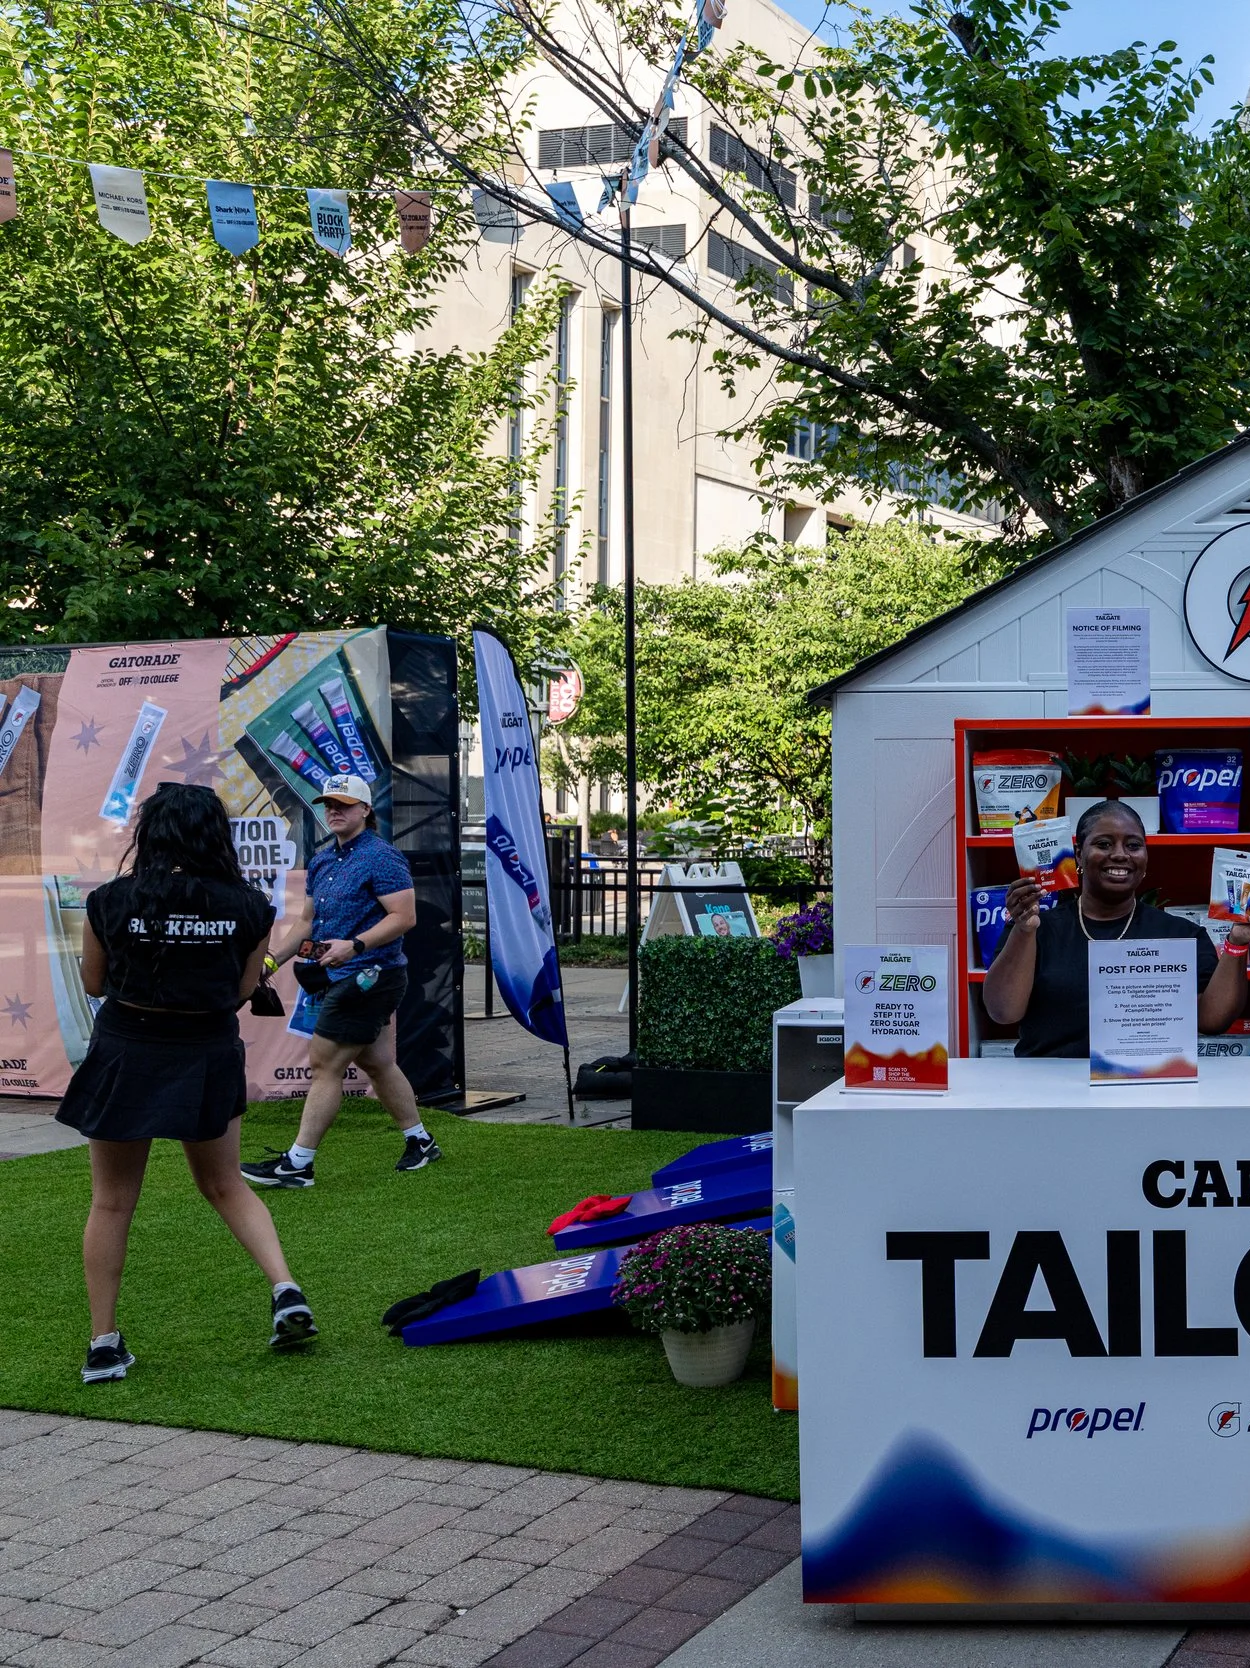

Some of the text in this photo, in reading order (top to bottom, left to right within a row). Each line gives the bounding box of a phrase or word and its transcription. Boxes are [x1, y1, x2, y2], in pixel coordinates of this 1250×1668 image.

[98, 191, 143, 205] MICHAEL KORS
[316, 212, 344, 228] BLOCK
[317, 225, 345, 240] PARTY
[109, 654, 181, 669] GATORADE
[118, 676, 133, 687] OFF
[139, 675, 150, 686] TO
[150, 673, 180, 685] COLLEGE
[124, 736, 147, 779] ZERO
[337, 722, 378, 783] propel
[997, 774, 1048, 790] ZERO
[1158, 765, 1243, 795] propel
[1028, 839, 1059, 851] TAILGATE
[182, 920, 237, 936] PARTY
[879, 955, 912, 963] TAILGATE
[1098, 964, 1188, 974] POST FOR PERKS
[878, 974, 937, 992] ZERO
[875, 1003, 914, 1011] READY TO
[873, 1011, 916, 1019] STEP IT UP.
[869, 1019, 920, 1028] ZERO SUGAR
[871, 1028, 920, 1036] HYDRATION.
[1197, 1042, 1244, 1057] ZERO
[1026, 1401, 1146, 1440] propel
